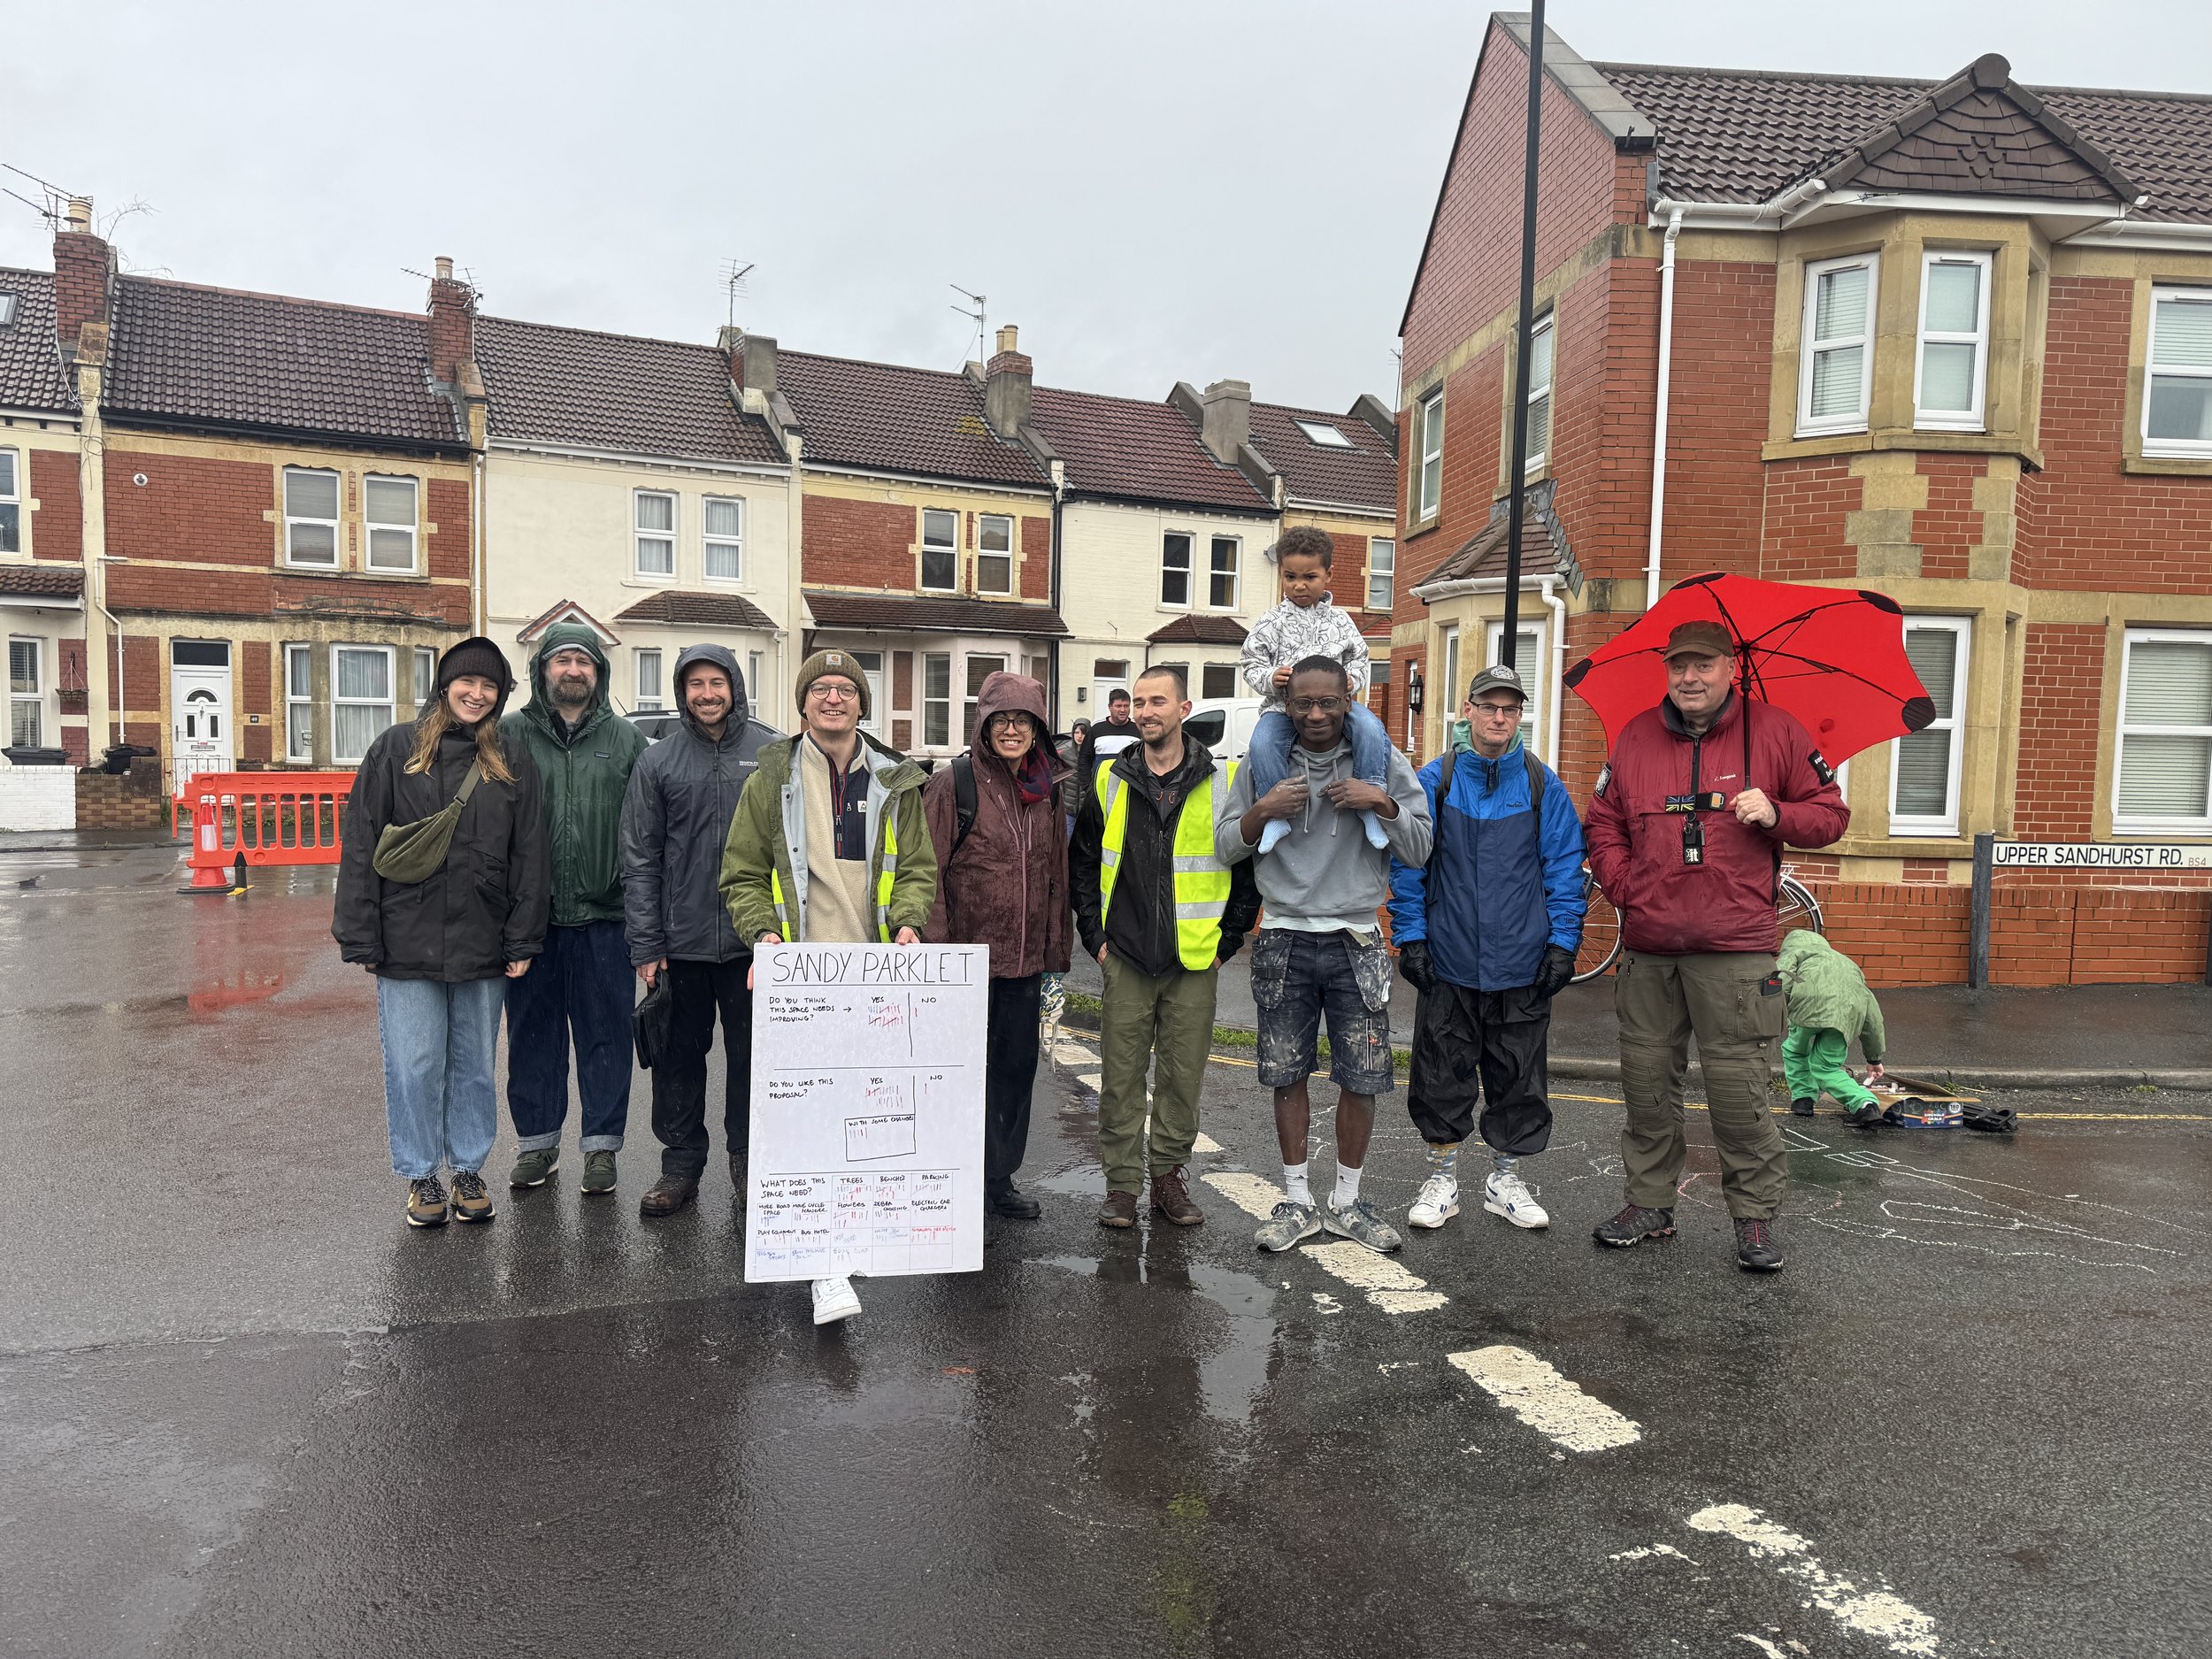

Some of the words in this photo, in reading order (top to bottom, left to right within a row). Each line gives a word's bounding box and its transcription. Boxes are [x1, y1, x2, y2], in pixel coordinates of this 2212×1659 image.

[1996, 846, 2047, 864] UPPER
[2055, 847, 2154, 864] SANDHURST
[2159, 849, 2184, 865] RD.
[2188, 857, 2207, 867] BS4
[772, 952, 852, 982] SANDY
[863, 953, 974, 982] PARKLET
[770, 1014, 814, 1023] IMPROVING?
[770, 1089, 808, 1100] PROPOSAL?
[761, 1179, 787, 1188] WHAT
[789, 1187, 812, 1196] NEED?
